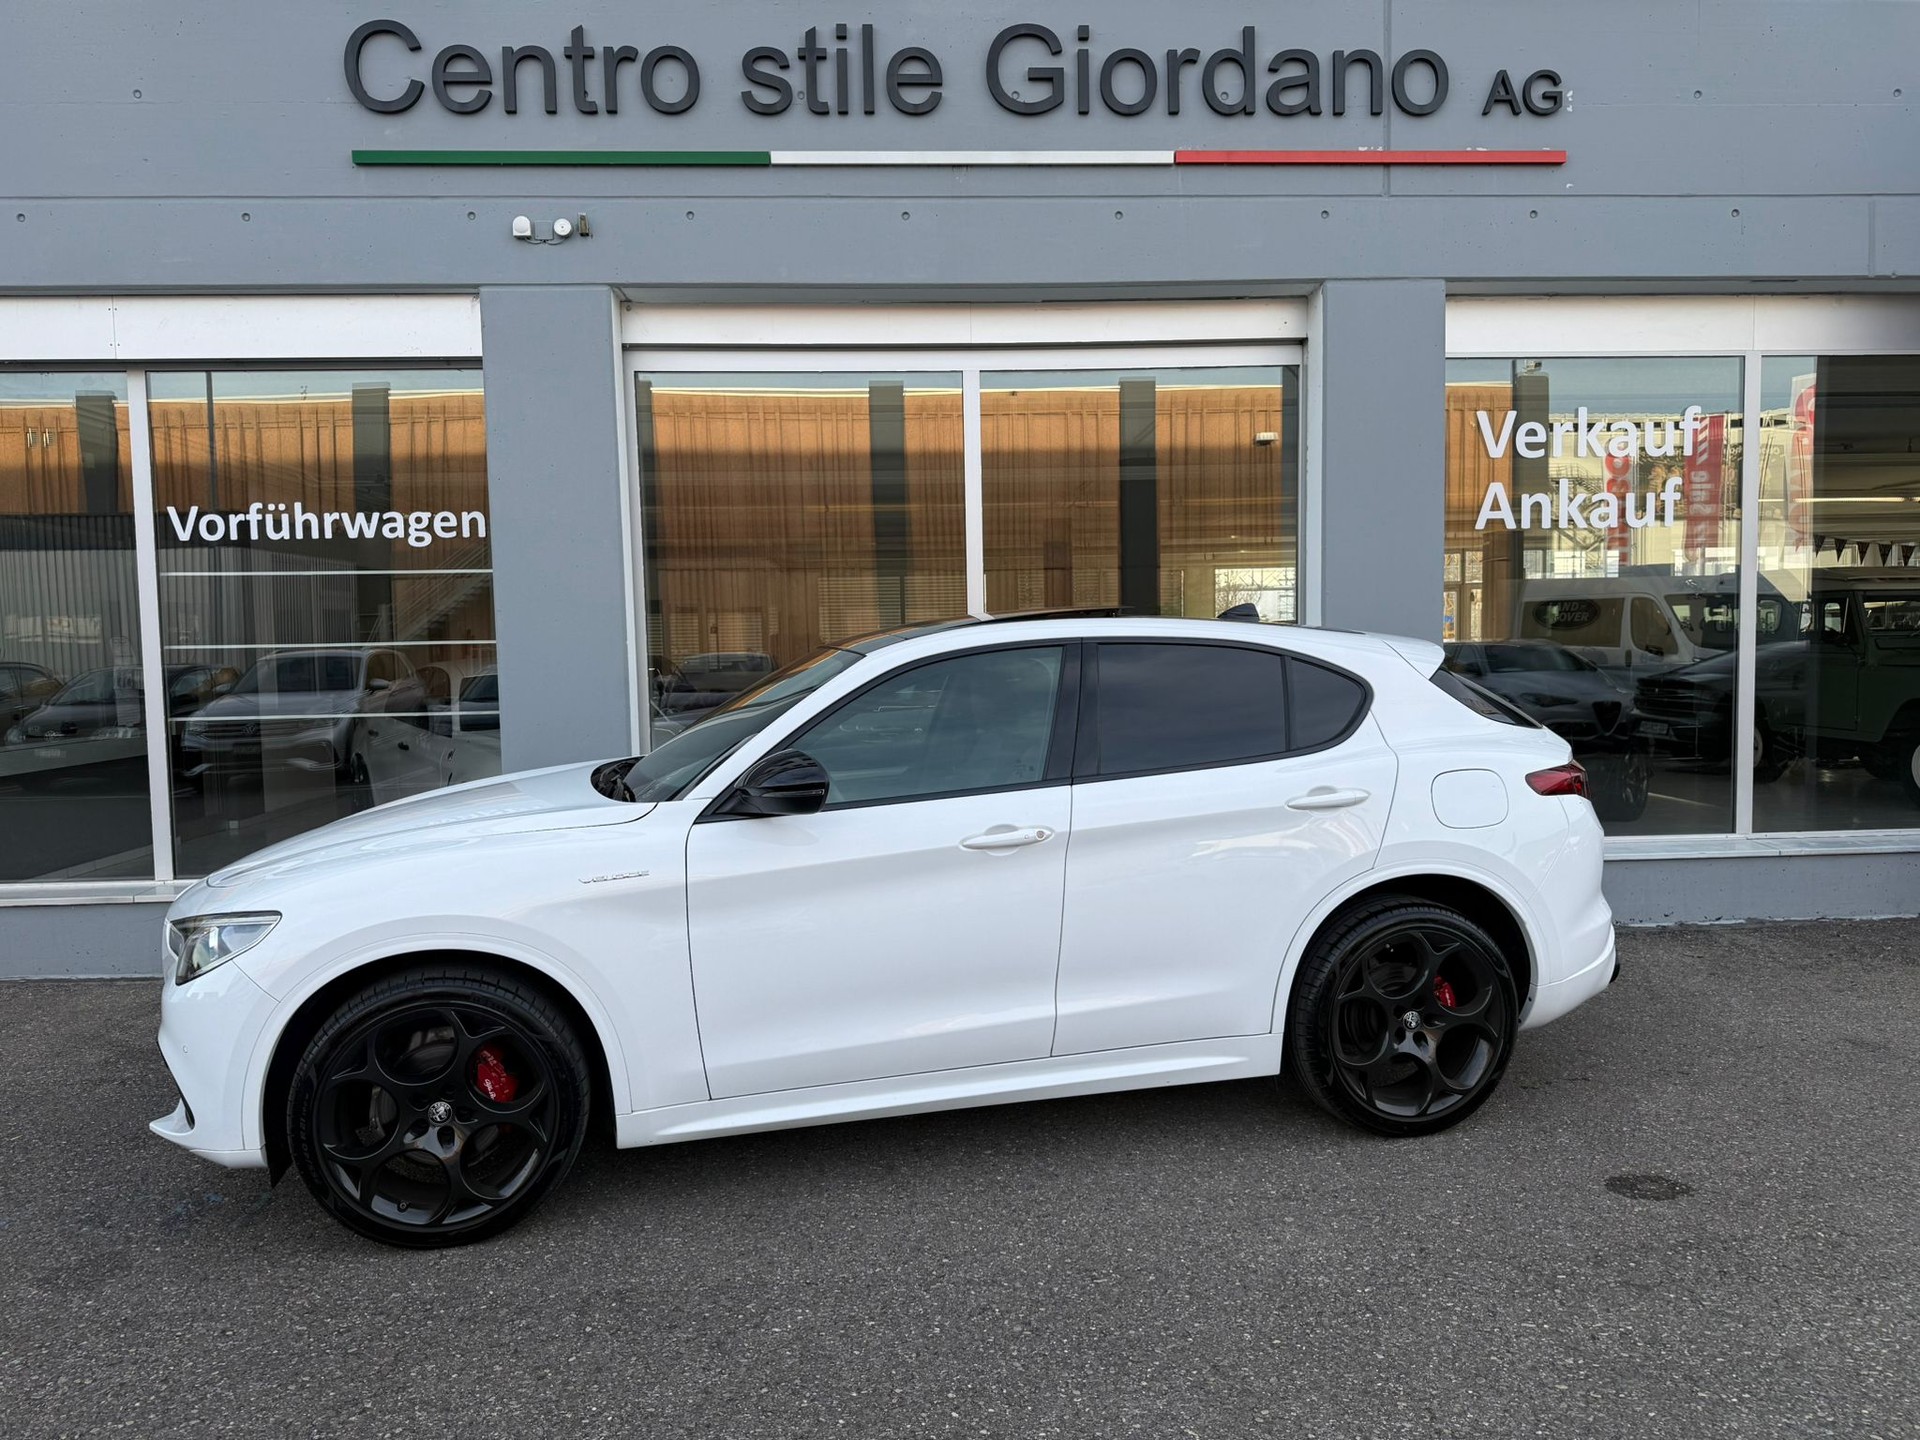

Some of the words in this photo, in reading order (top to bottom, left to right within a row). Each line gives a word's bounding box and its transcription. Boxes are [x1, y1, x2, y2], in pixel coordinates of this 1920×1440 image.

[344, 19, 701, 116] Centro
[740, 23, 943, 116] stile
[985, 22, 1449, 117] Giordano
[1482, 69, 1565, 116] AG
[1476, 405, 1702, 459] Verkauf
[167, 502, 486, 547] Vorführwagen
[1475, 477, 1683, 530] Ankauf
[1550, 601, 1579, 612] AND
